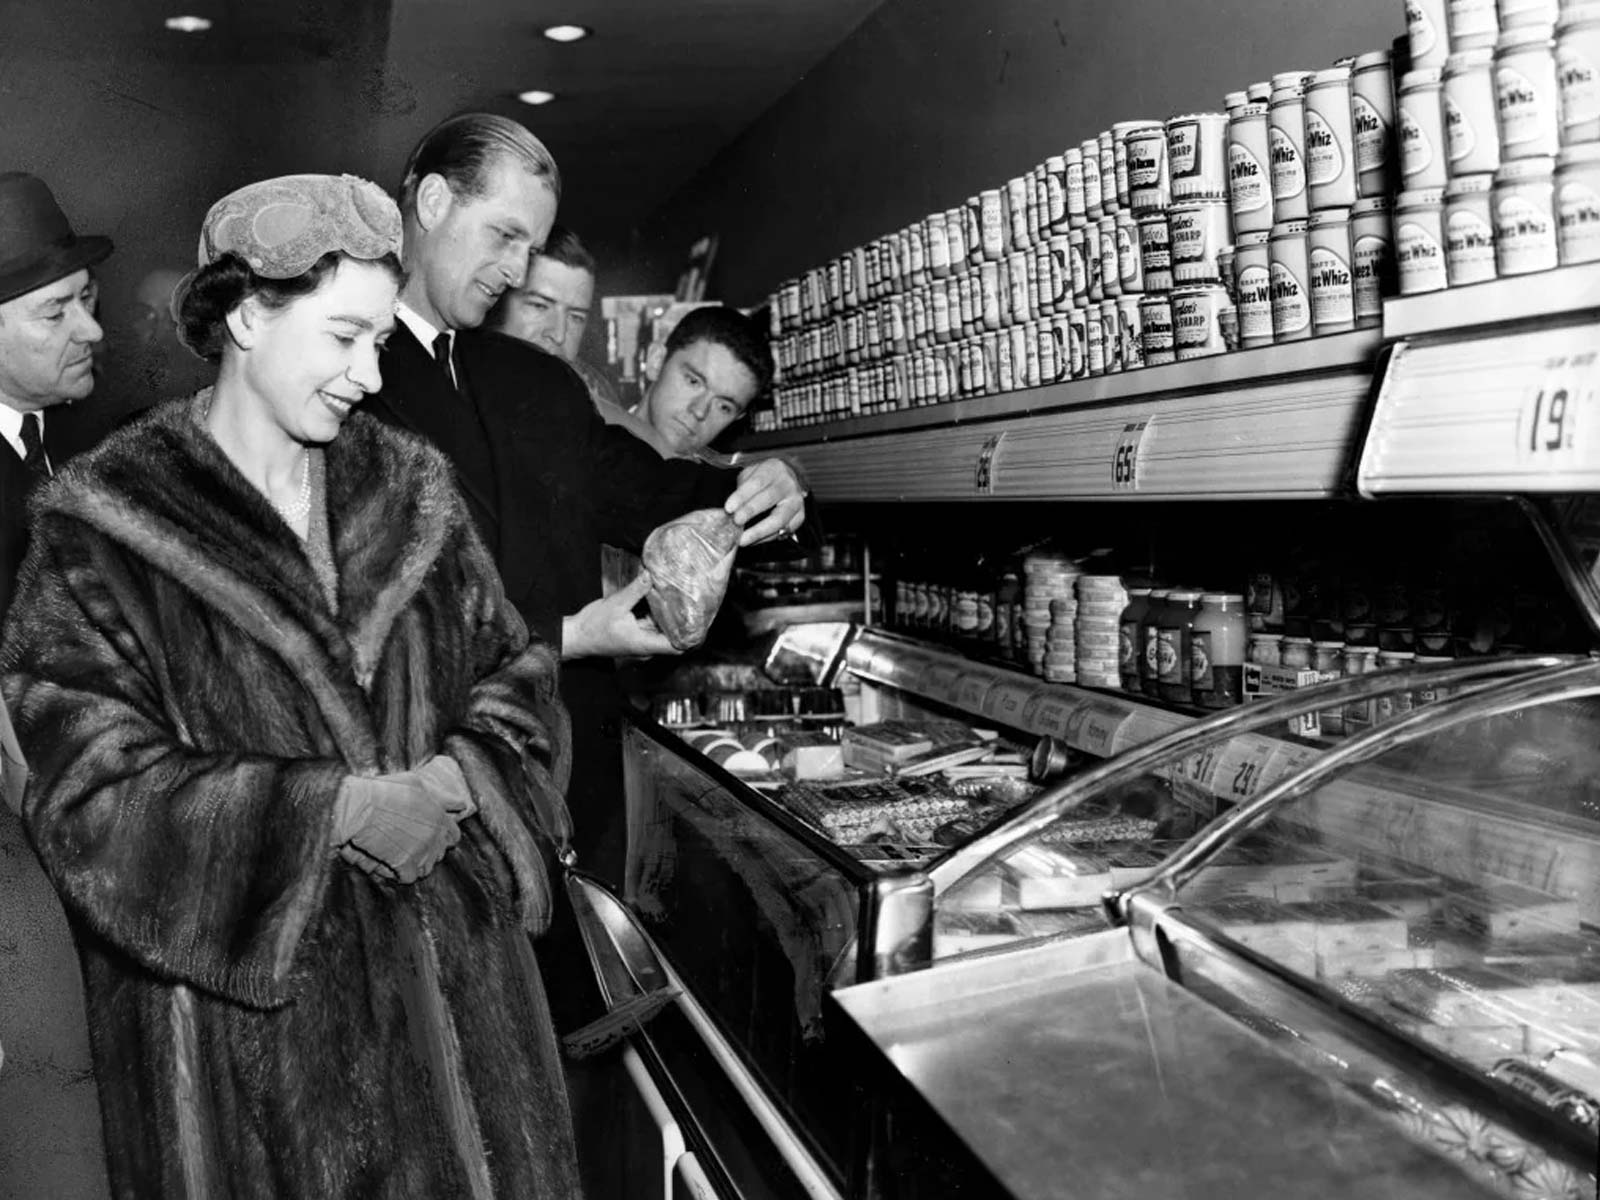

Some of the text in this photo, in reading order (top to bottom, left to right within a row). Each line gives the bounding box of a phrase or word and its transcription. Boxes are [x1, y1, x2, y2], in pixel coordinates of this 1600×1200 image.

[1355, 115, 1379, 134] Whiz
[1309, 131, 1332, 148] Whiz
[1274, 147, 1295, 164] Whiz
[1235, 162, 1259, 179] Whiz
[1321, 269, 1349, 287] Whiz
[1275, 281, 1298, 298] Whiz
[1179, 315, 1205, 328] SHARP
[1530, 388, 1568, 452] 19
[1116, 445, 1134, 483] 65
